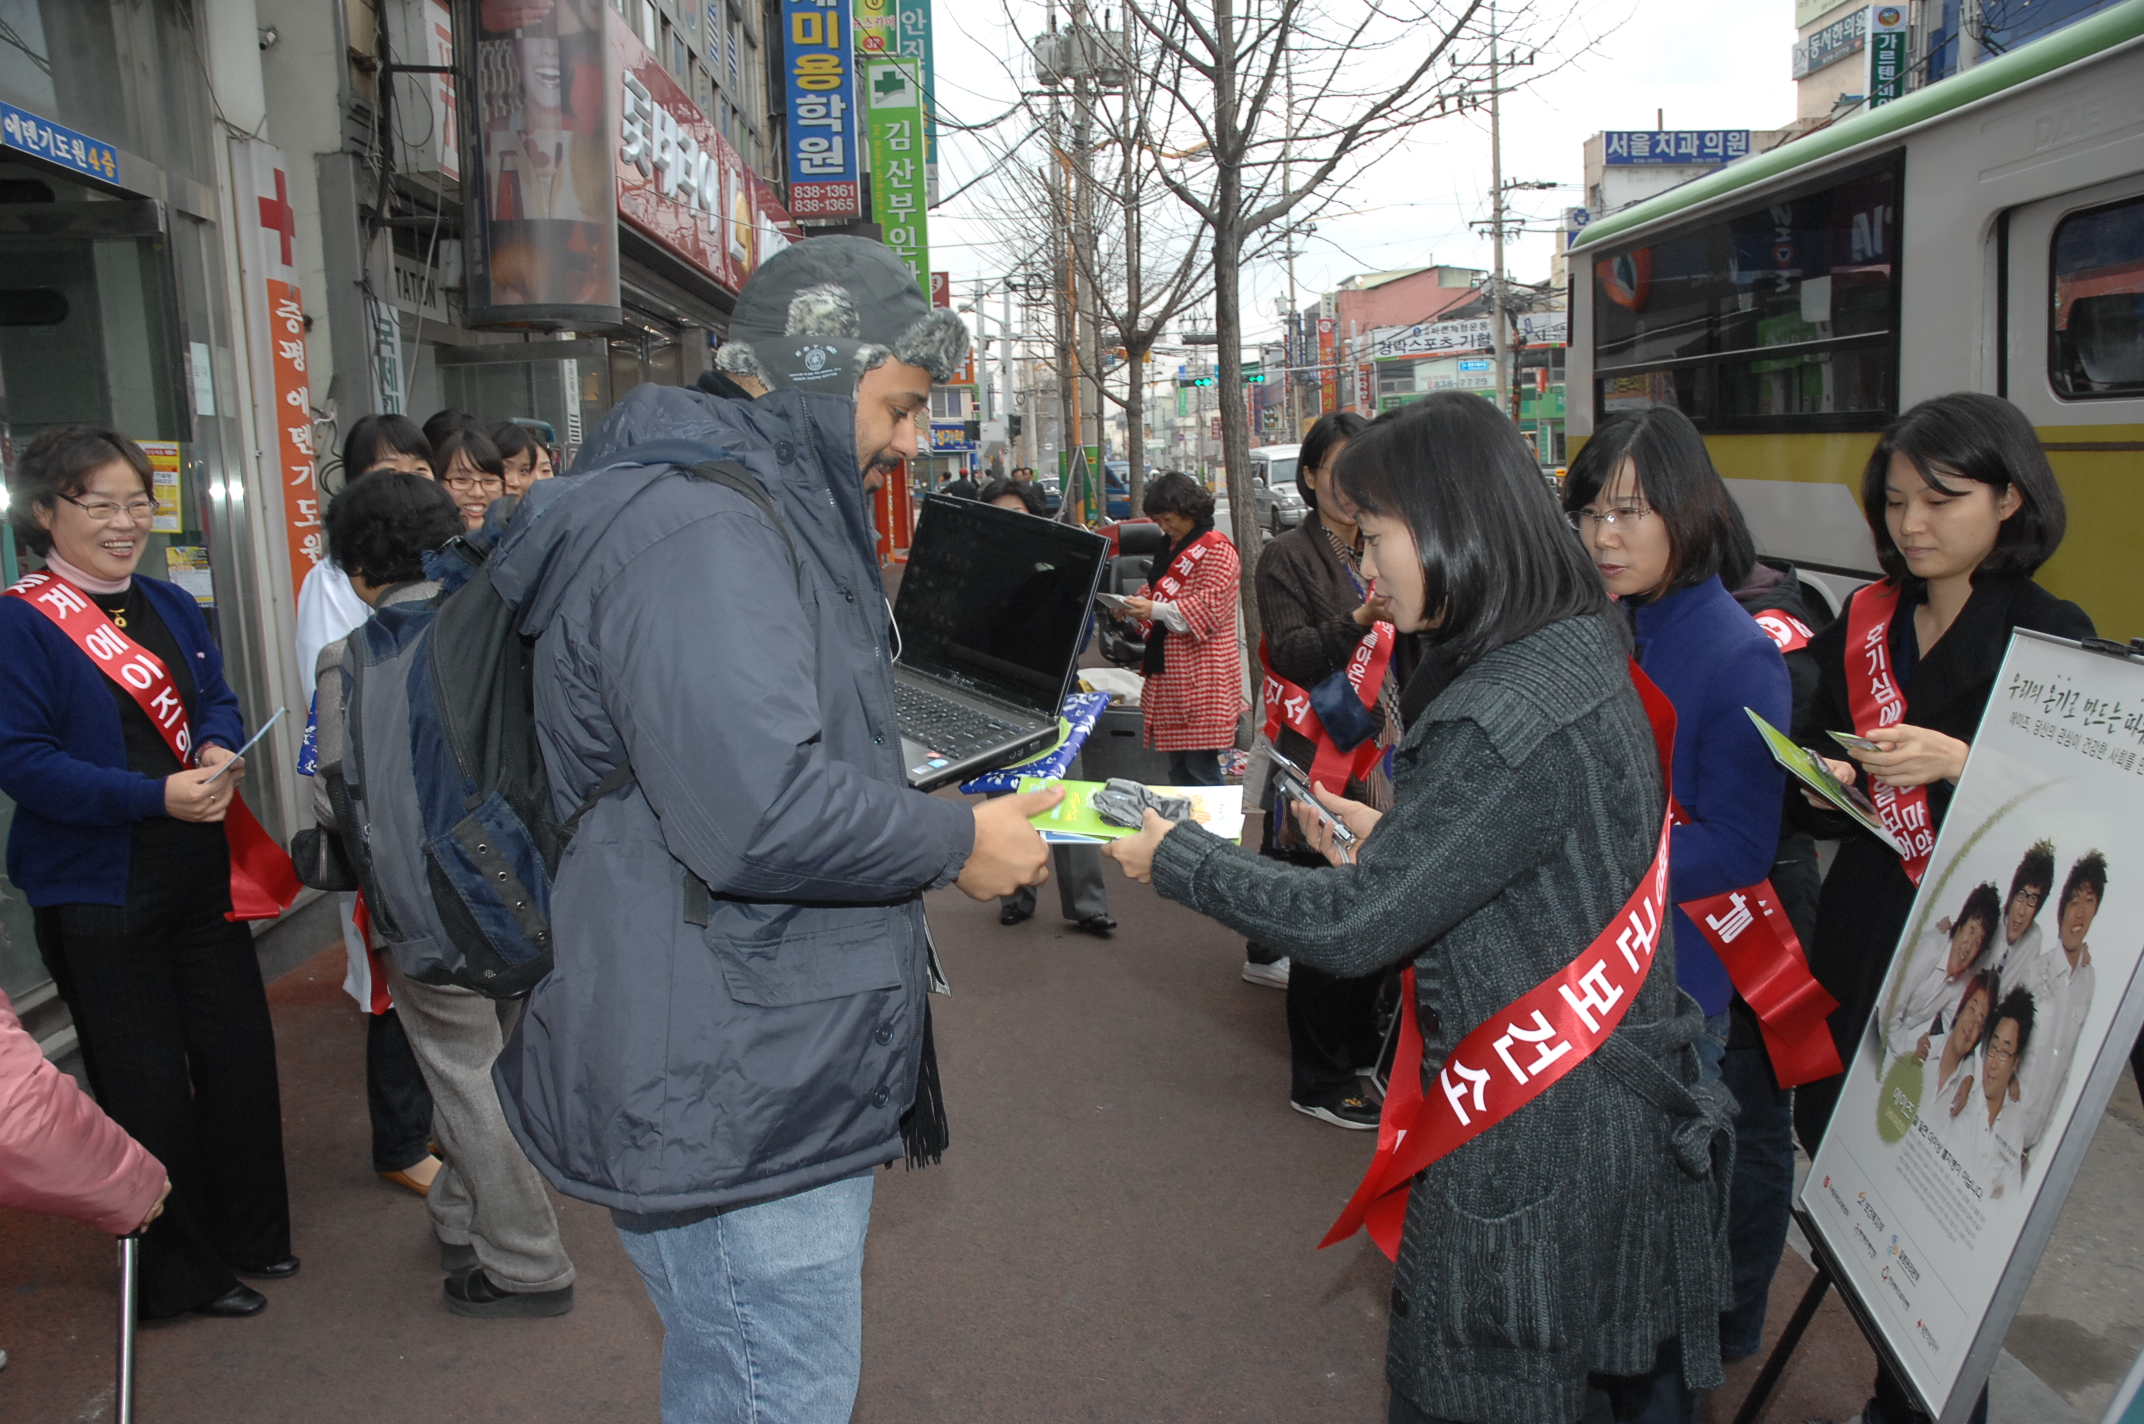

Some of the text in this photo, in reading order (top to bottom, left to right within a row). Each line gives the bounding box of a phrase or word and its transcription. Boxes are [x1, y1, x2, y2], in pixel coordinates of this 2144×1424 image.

[790, 0, 848, 175] 미용학원
[4, 113, 88, 168] 에덴기도원
[622, 69, 719, 235] 롯데리아
[794, 183, 854, 198] 838-1361
[794, 198, 854, 212] 838-1365
[276, 299, 304, 371] 증평
[1864, 622, 1902, 727] 호기심에
[2009, 673, 2044, 705] 우리의
[2043, 684, 2081, 719] 온기로
[1705, 892, 1754, 943] 날
